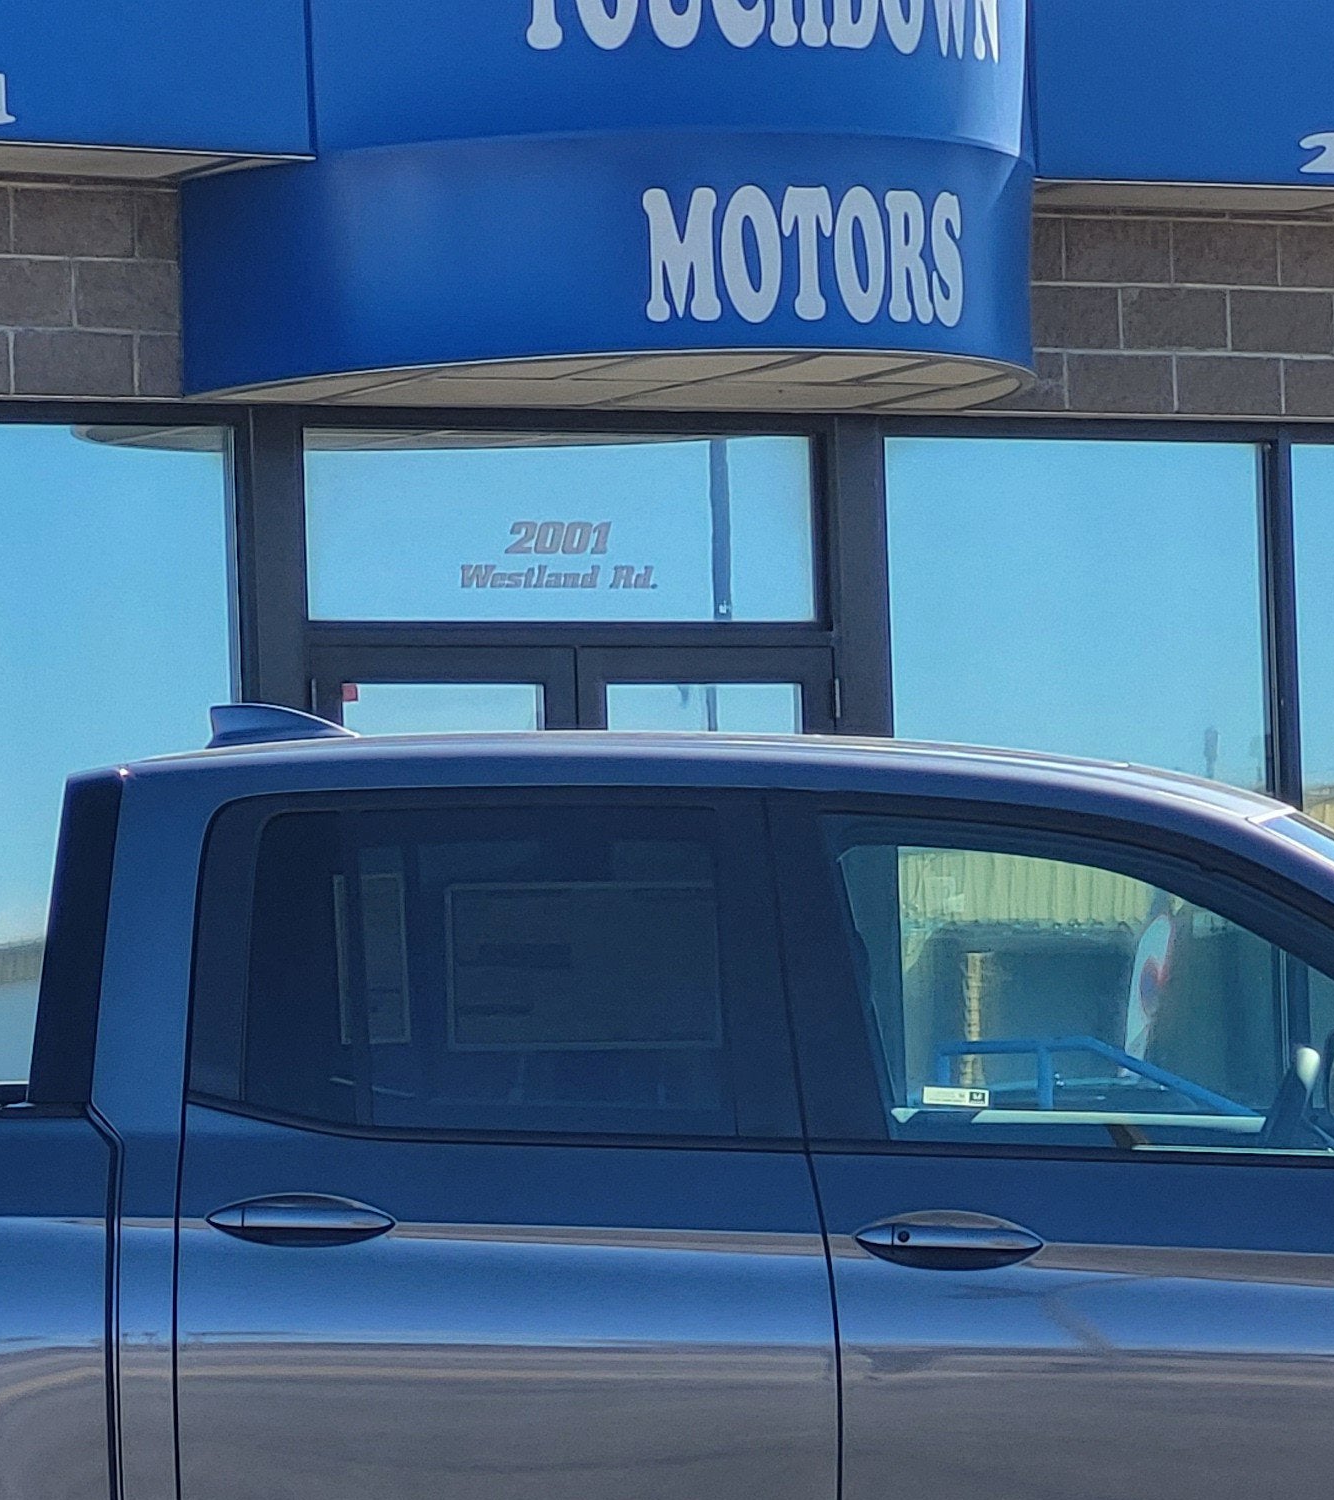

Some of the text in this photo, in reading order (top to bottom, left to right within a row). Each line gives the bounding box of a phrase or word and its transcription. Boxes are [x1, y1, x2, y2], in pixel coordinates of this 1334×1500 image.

[642, 184, 963, 327] MOTORS
[504, 520, 612, 555] 2001
[460, 563, 659, 590] Westland Rd.
